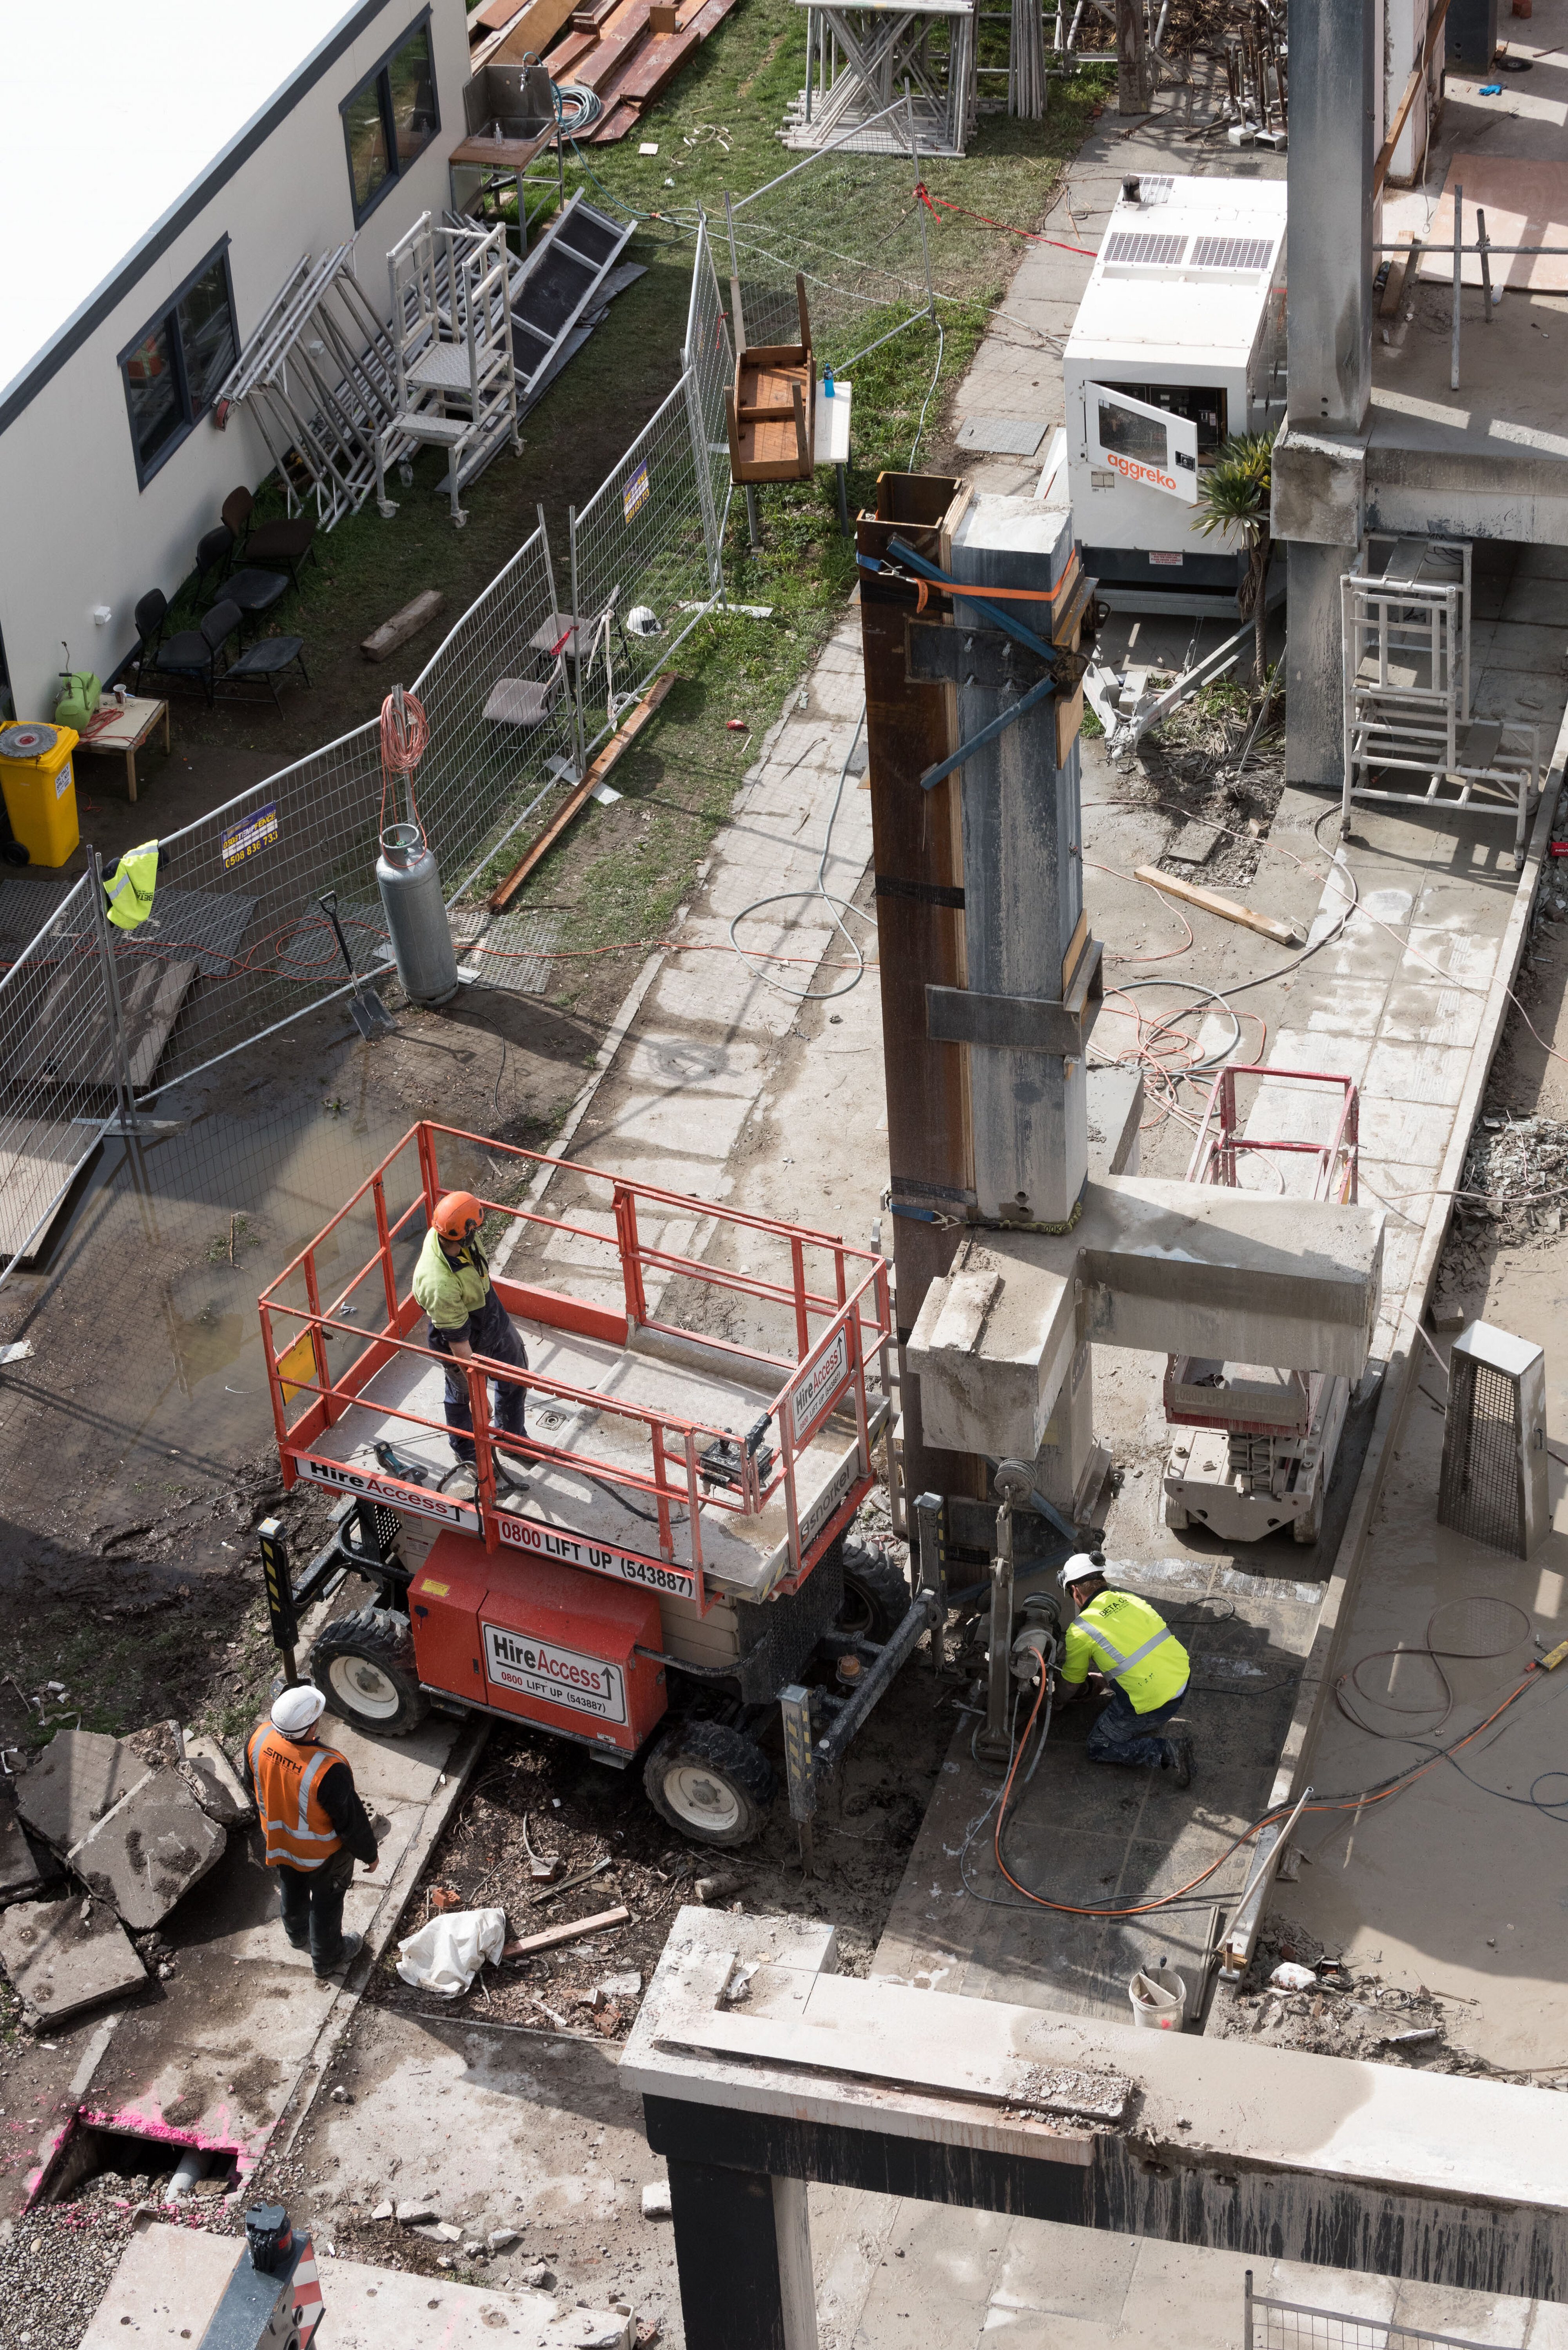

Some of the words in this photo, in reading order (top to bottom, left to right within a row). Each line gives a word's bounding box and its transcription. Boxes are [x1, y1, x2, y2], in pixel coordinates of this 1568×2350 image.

[1107, 454, 1176, 490] aggreko
[225, 850, 245, 868] 0508
[247, 840, 261, 856] 836
[263, 830, 278, 845] 733
[796, 1350, 838, 1415] HireAccess
[799, 1416, 809, 1431] 0800
[809, 1402, 818, 1417] LIFT
[818, 1394, 824, 1405] UP
[825, 1370, 840, 1397] (543887)
[310, 1461, 448, 1514] HireAccess
[810, 1464, 849, 1531] snorkel
[502, 1521, 541, 1548] 0800
[545, 1534, 581, 1561] LIFT
[589, 1547, 612, 1569] UP
[621, 1558, 693, 1598] (543887)
[1099, 1603, 1120, 1617] BETA
[493, 1634, 601, 1690] HireAccess
[501, 1671, 523, 1686] 0800
[526, 1680, 547, 1693] LIFT
[550, 1687, 563, 1698] UP
[567, 1692, 606, 1713] (543887)
[263, 1747, 303, 1773] SMITH
